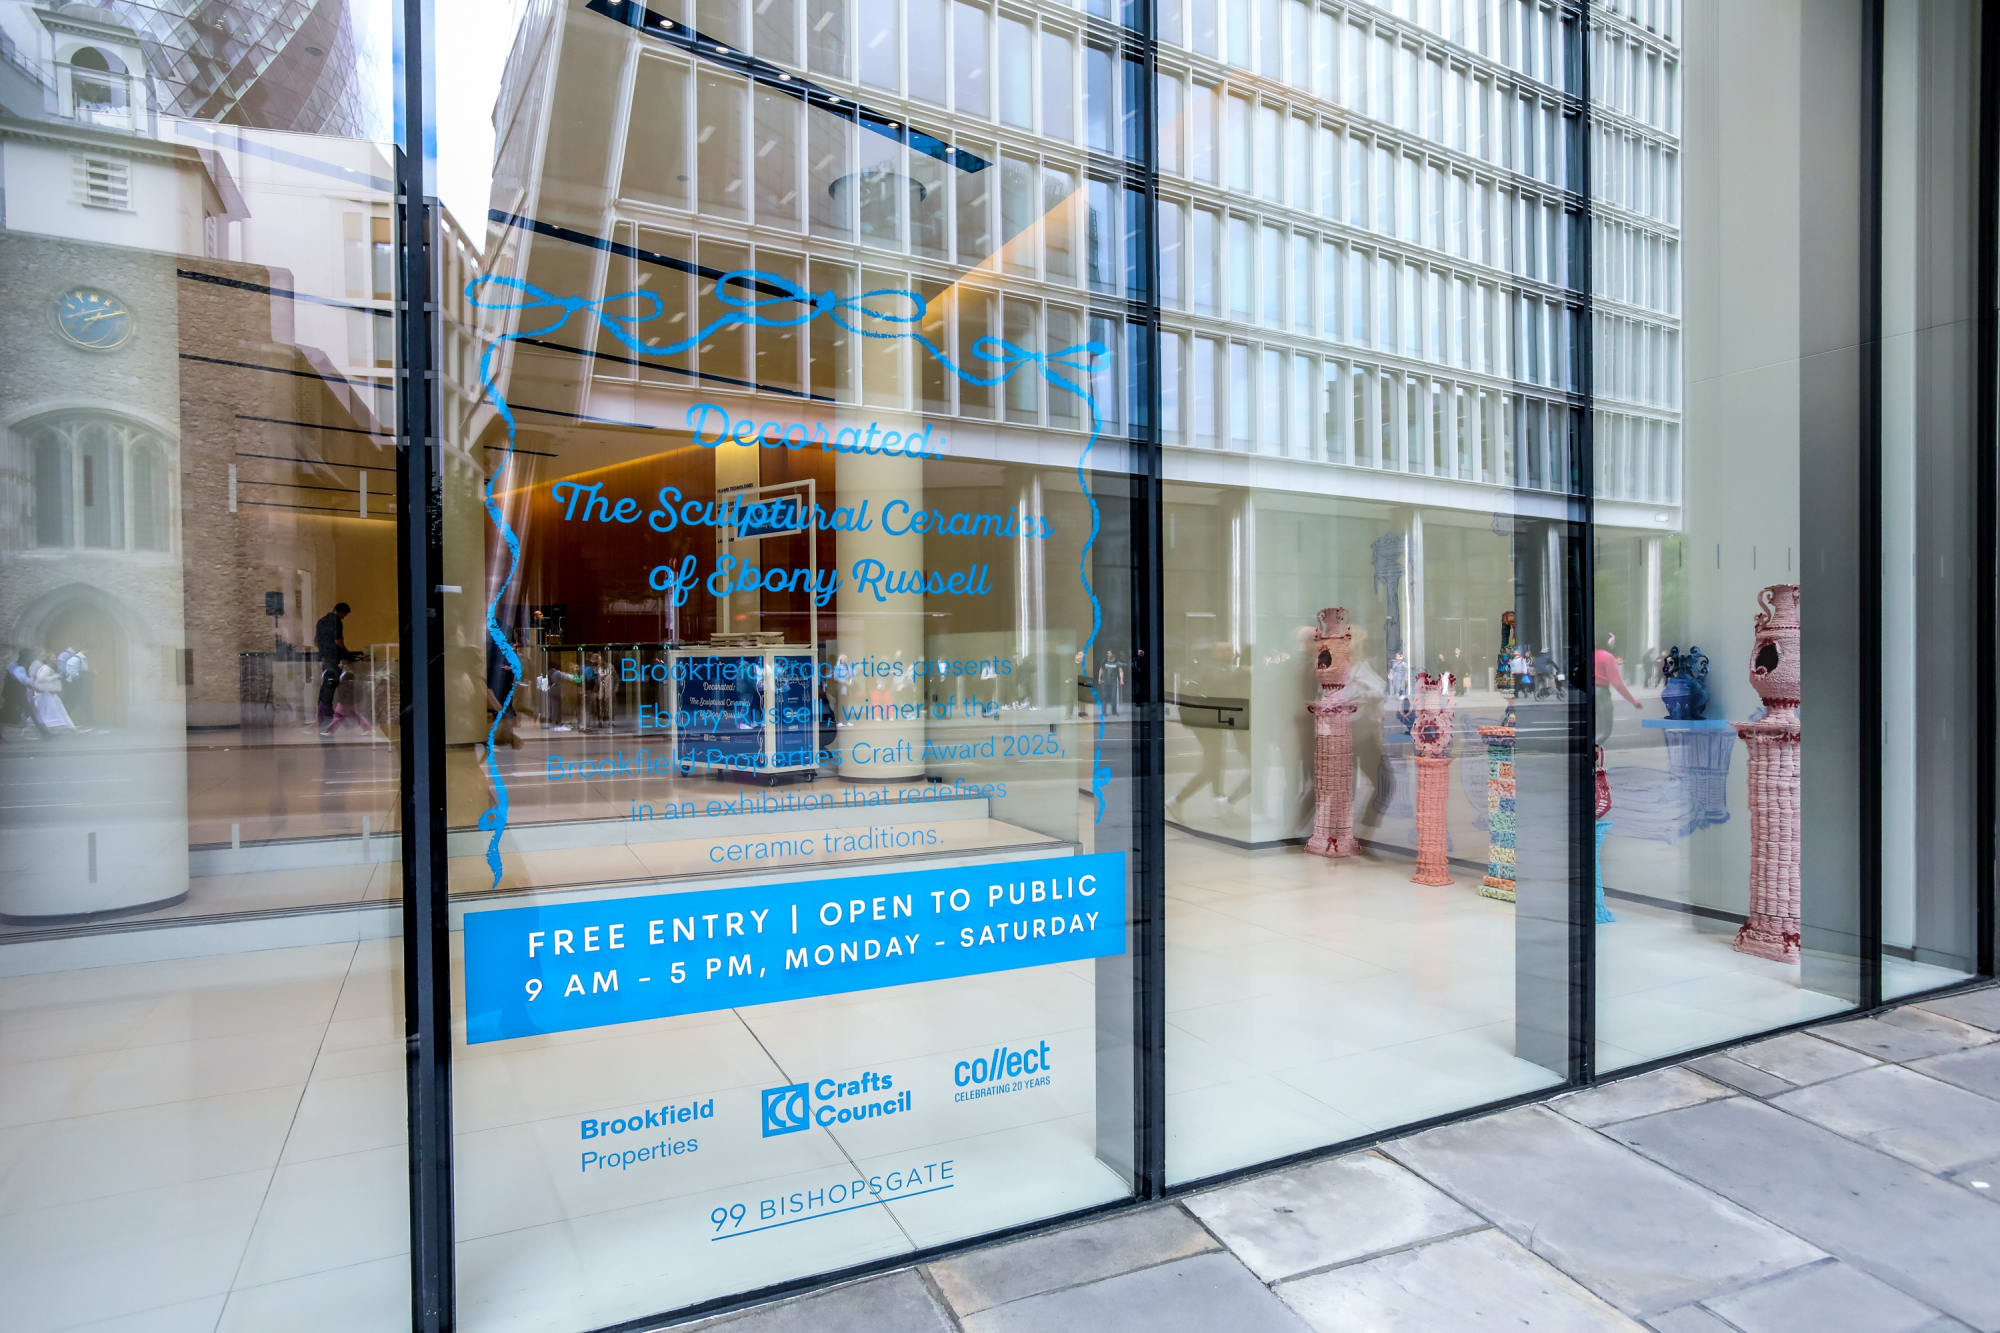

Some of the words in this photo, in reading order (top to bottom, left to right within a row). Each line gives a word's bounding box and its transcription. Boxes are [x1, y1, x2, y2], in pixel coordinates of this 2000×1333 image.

[685, 403, 947, 460] Decorated:
[552, 482, 642, 522] The
[649, 487, 872, 538] Sculptural
[882, 499, 1055, 539] Ceramics
[649, 555, 698, 604] of
[707, 554, 843, 606] Ebony
[852, 559, 992, 602] Russell
[622, 655, 763, 682] Brookfield
[774, 656, 903, 686] Properties
[913, 656, 1011, 683] presents
[638, 702, 724, 734] Ebony
[734, 699, 831, 728] Russell,
[842, 699, 924, 721] winner
[932, 696, 955, 718] of
[963, 696, 999, 717] the
[547, 747, 696, 780] Brookfield
[707, 743, 843, 776] Properties
[852, 740, 912, 764] Craft
[921, 736, 994, 760] Award
[1003, 734, 1065, 759] 2025,
[632, 800, 653, 822] in
[664, 802, 696, 820] an
[706, 790, 834, 817] exhibition
[844, 787, 888, 808] that
[899, 778, 1007, 804] redefines
[710, 837, 814, 863] ceramic
[823, 826, 944, 853] traditions.
[529, 924, 624, 957] FREE
[650, 910, 768, 944] ENTRY
[820, 895, 911, 925] OPEN
[931, 889, 970, 913] TO
[990, 875, 1096, 907] PUBLIC
[526, 979, 542, 1001] 9
[565, 970, 618, 996] AM
[671, 962, 685, 983] 5
[707, 955, 765, 979] PM,
[786, 934, 919, 969] MONDAY
[960, 911, 1098, 947] SATURDAY
[815, 1072, 893, 1100] Crafts
[955, 1084, 1010, 1102] CELEBRATING
[1012, 1081, 1022, 1091] 20
[1024, 1076, 1050, 1088] YEARS
[581, 1099, 714, 1140] Brookfield
[815, 1090, 911, 1127] Council
[581, 1136, 698, 1172] Properties
[711, 1203, 747, 1233] 99
[760, 1160, 953, 1221] BISHOPSGATE
